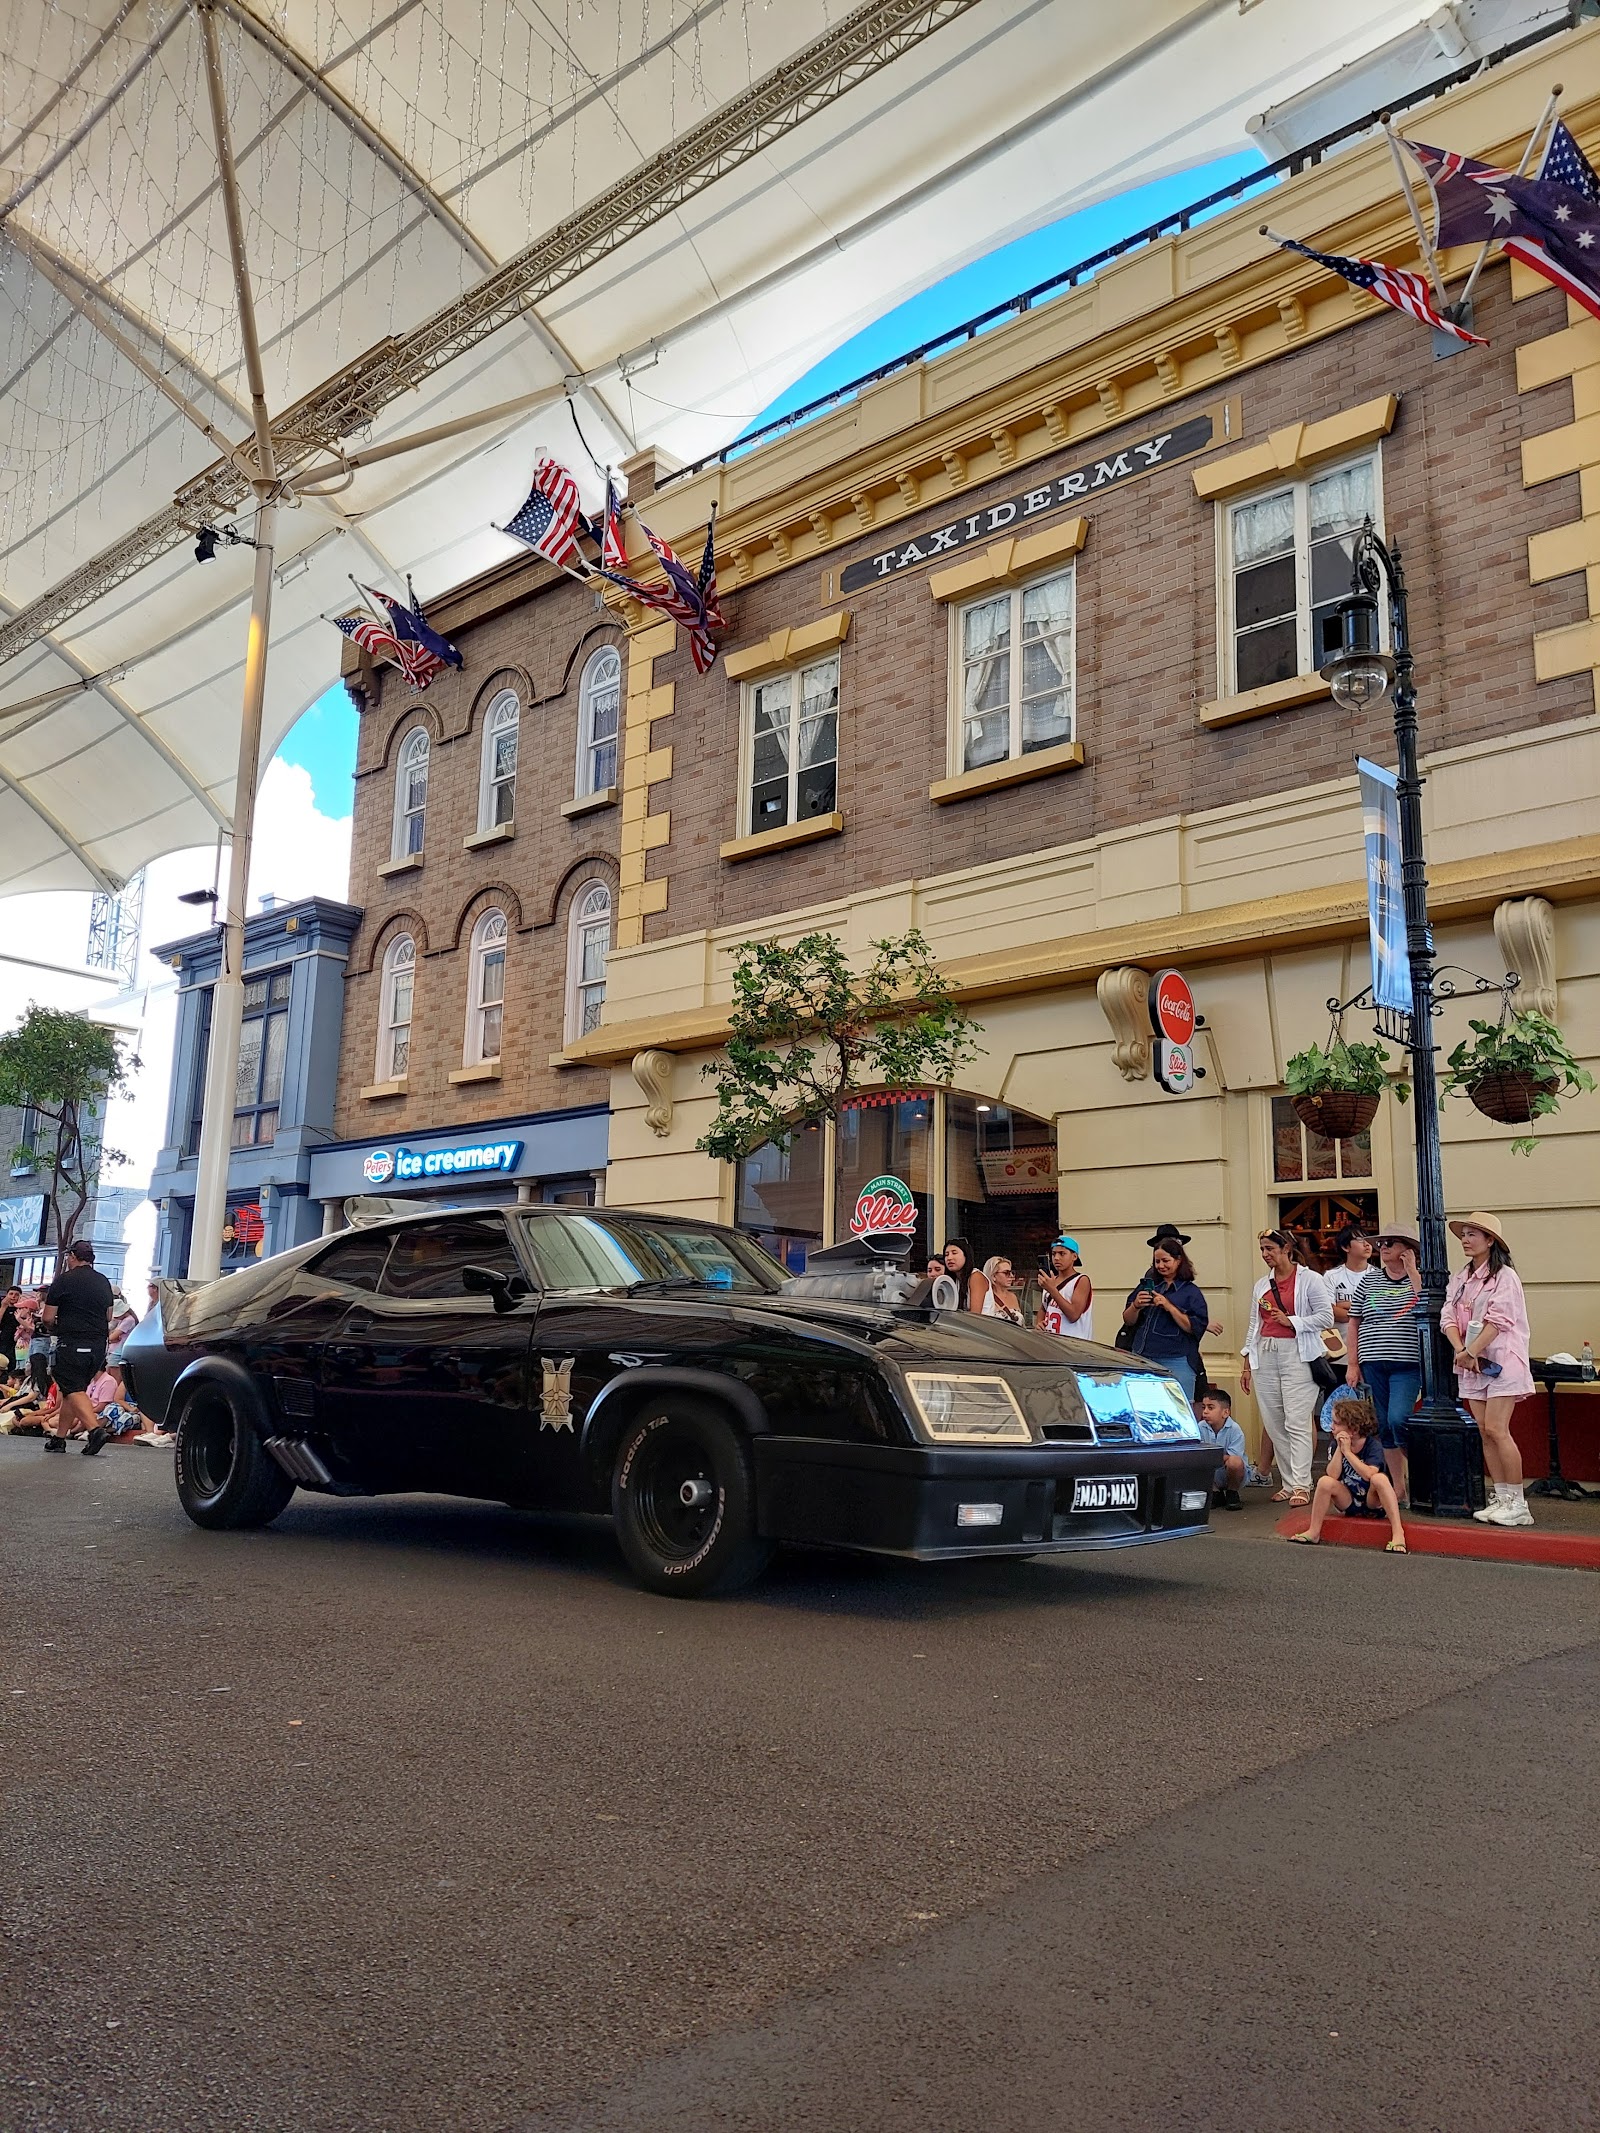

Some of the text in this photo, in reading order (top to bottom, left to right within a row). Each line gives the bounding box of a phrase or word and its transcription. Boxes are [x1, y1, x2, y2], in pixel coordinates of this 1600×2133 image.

[873, 433, 1172, 577] TAXIDERMY
[1168, 1054, 1188, 1072] Slice
[397, 1143, 516, 1175] ice creamery
[869, 1179, 908, 1197] MAIN STREET
[850, 1195, 918, 1233] Slice
[619, 1415, 670, 1489] Radial T/A
